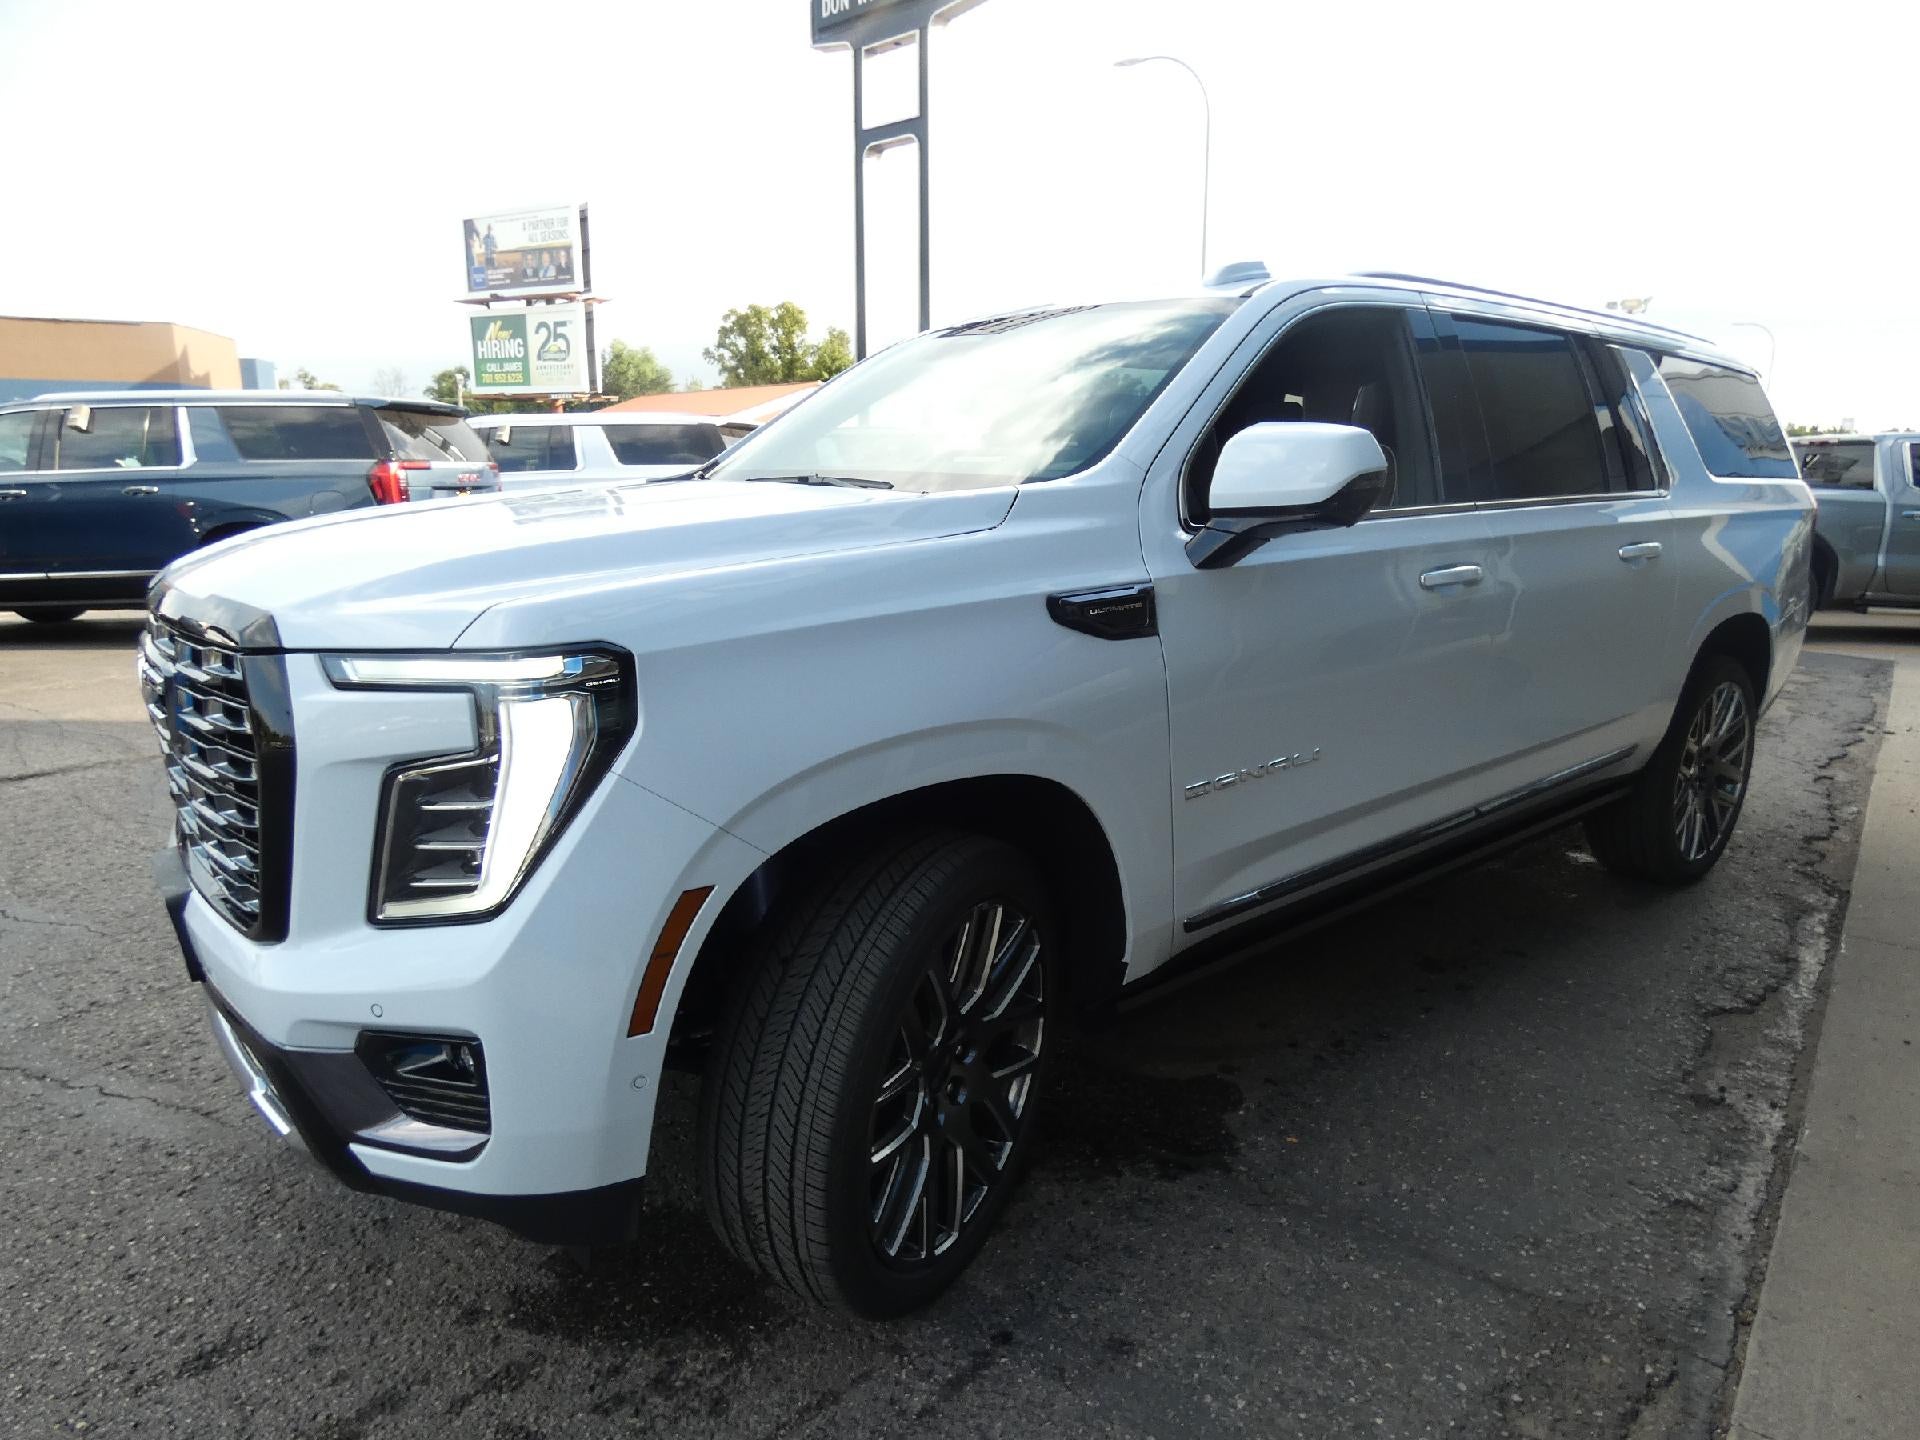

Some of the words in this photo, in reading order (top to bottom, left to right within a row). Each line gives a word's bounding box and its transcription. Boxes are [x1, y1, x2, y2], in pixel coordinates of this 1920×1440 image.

[821, 0, 850, 18] DON
[528, 217, 554, 231] PARTNER
[477, 337, 525, 359] HIRING
[1184, 747, 1320, 801] DENALI
